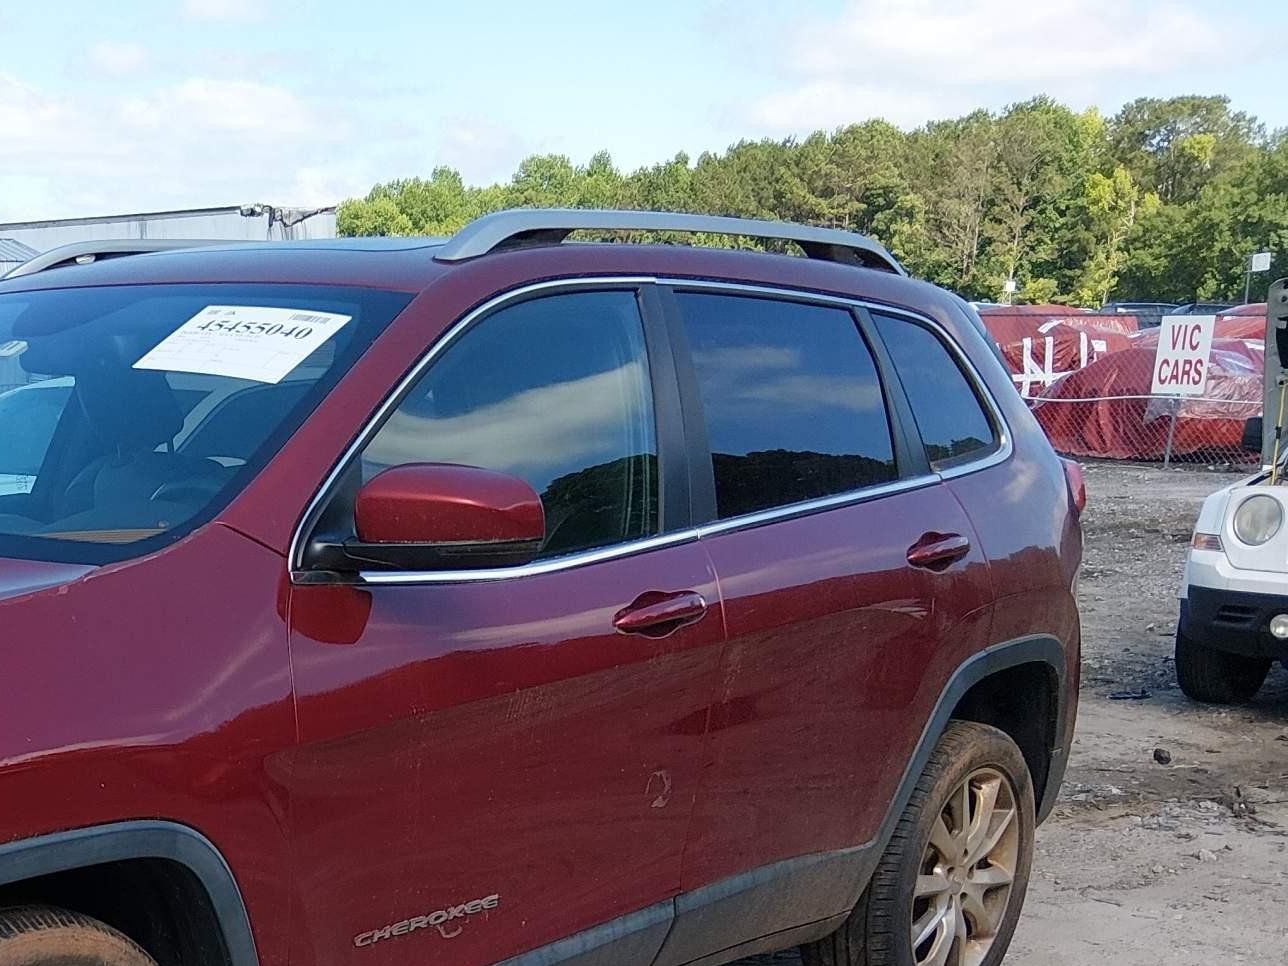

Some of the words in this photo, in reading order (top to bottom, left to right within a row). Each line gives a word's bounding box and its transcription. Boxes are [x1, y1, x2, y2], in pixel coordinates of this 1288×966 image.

[197, 319, 313, 340] 45455040
[1171, 324, 1202, 351] VIC
[1158, 358, 1204, 385] CARS
[353, 893, 499, 947] CHEROKEE
